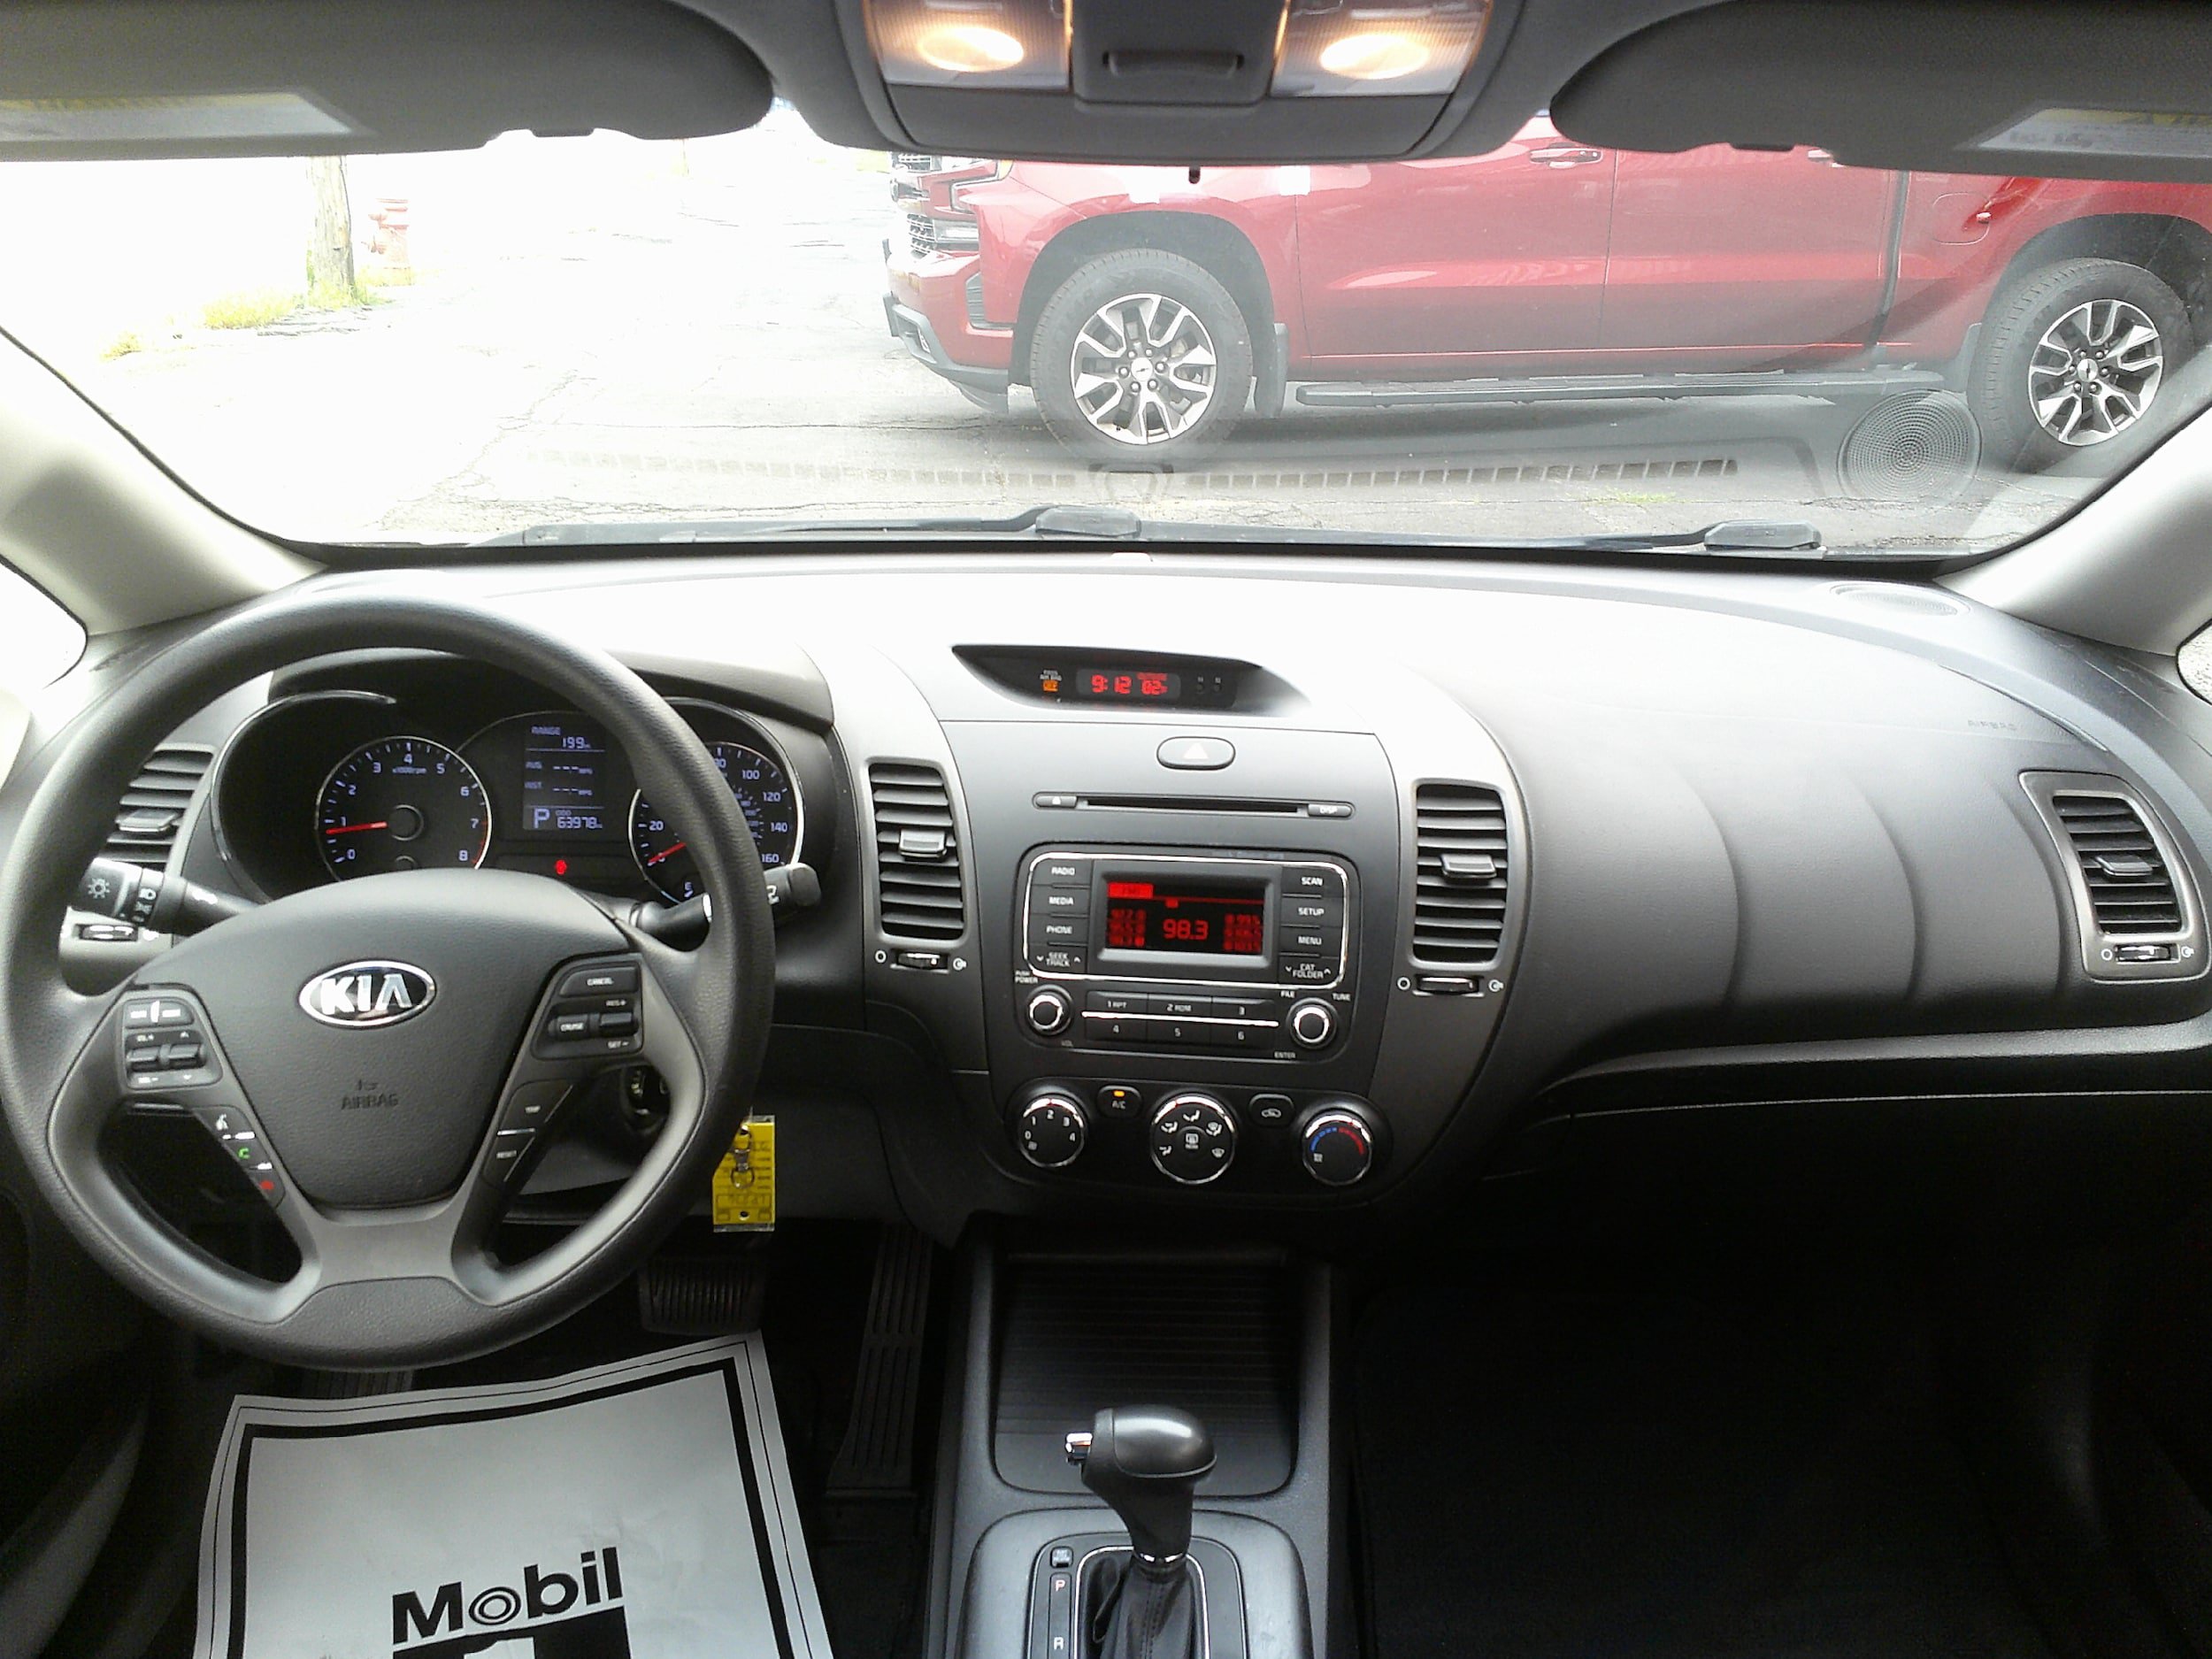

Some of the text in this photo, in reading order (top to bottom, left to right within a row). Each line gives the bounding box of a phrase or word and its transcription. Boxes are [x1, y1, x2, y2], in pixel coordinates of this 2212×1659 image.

[562, 736, 586, 749] 199
[403, 753, 413, 764] 4
[373, 762, 381, 773] 3
[435, 764, 445, 774] 5
[741, 770, 760, 780] 100
[349, 785, 357, 795] 2
[460, 787, 470, 796] 6
[763, 791, 781, 803] 120
[340, 816, 347, 827] 1
[470, 818, 479, 829] 7
[534, 808, 550, 829] P
[557, 816, 598, 829] 63978
[649, 820, 664, 832] 20
[771, 822, 788, 833] 140
[347, 849, 356, 860] 0
[458, 850, 468, 862] 8
[761, 854, 780, 864] 160
[1050, 866, 1076, 876] RADIO
[1301, 877, 1323, 886] SCAN
[1048, 896, 1074, 906] MEDIA
[1297, 907, 1325, 917] SETUP
[1045, 926, 1073, 934] PHONE
[1162, 918, 1210, 941] 98.3
[1297, 935, 1323, 946] MENU
[1300, 963, 1316, 972] CAT
[1292, 969, 1325, 979] FOLDER
[320, 973, 412, 1016] KIA
[1166, 1003, 1174, 1012] 2
[1239, 1006, 1247, 1016] 3
[1112, 1025, 1120, 1033] 4
[1174, 1027, 1182, 1037] 5
[1238, 1031, 1245, 1041] 6
[341, 1093, 399, 1110] AIRBAG
[1047, 1109, 1055, 1120] 2
[1063, 1116, 1071, 1127] 3
[1025, 1131, 1032, 1141] 0
[1069, 1132, 1076, 1142] 4
[1055, 1579, 1066, 1593] P
[393, 1547, 624, 1646] Mobil
